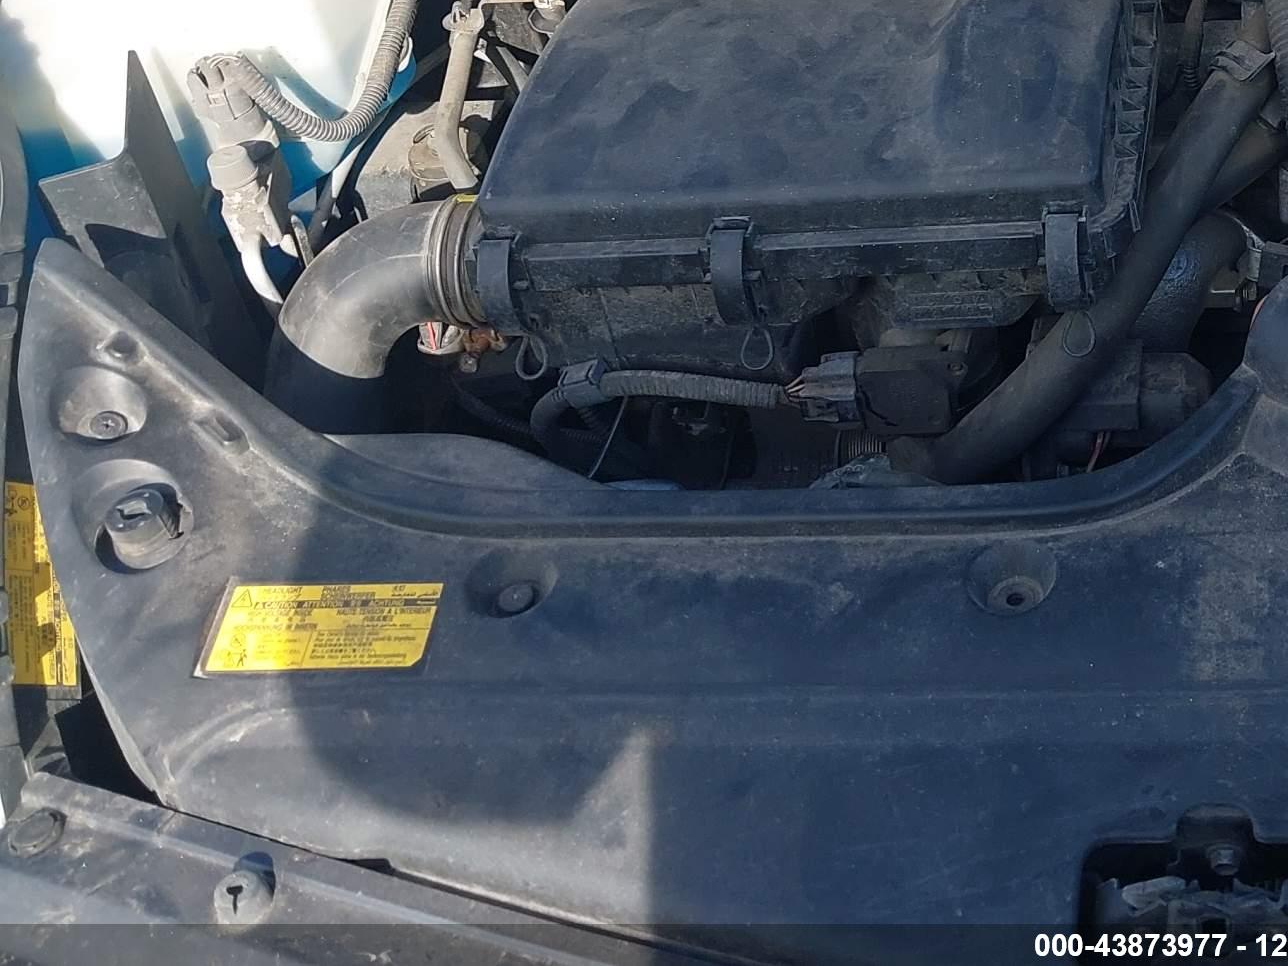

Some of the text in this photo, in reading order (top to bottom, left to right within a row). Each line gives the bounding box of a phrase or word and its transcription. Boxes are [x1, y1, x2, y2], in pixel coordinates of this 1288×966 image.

[263, 586, 302, 594] HEADLIGHT
[263, 601, 298, 609] CAUTION
[303, 600, 344, 608] ATTENTION
[369, 599, 405, 607] ACHTUNG
